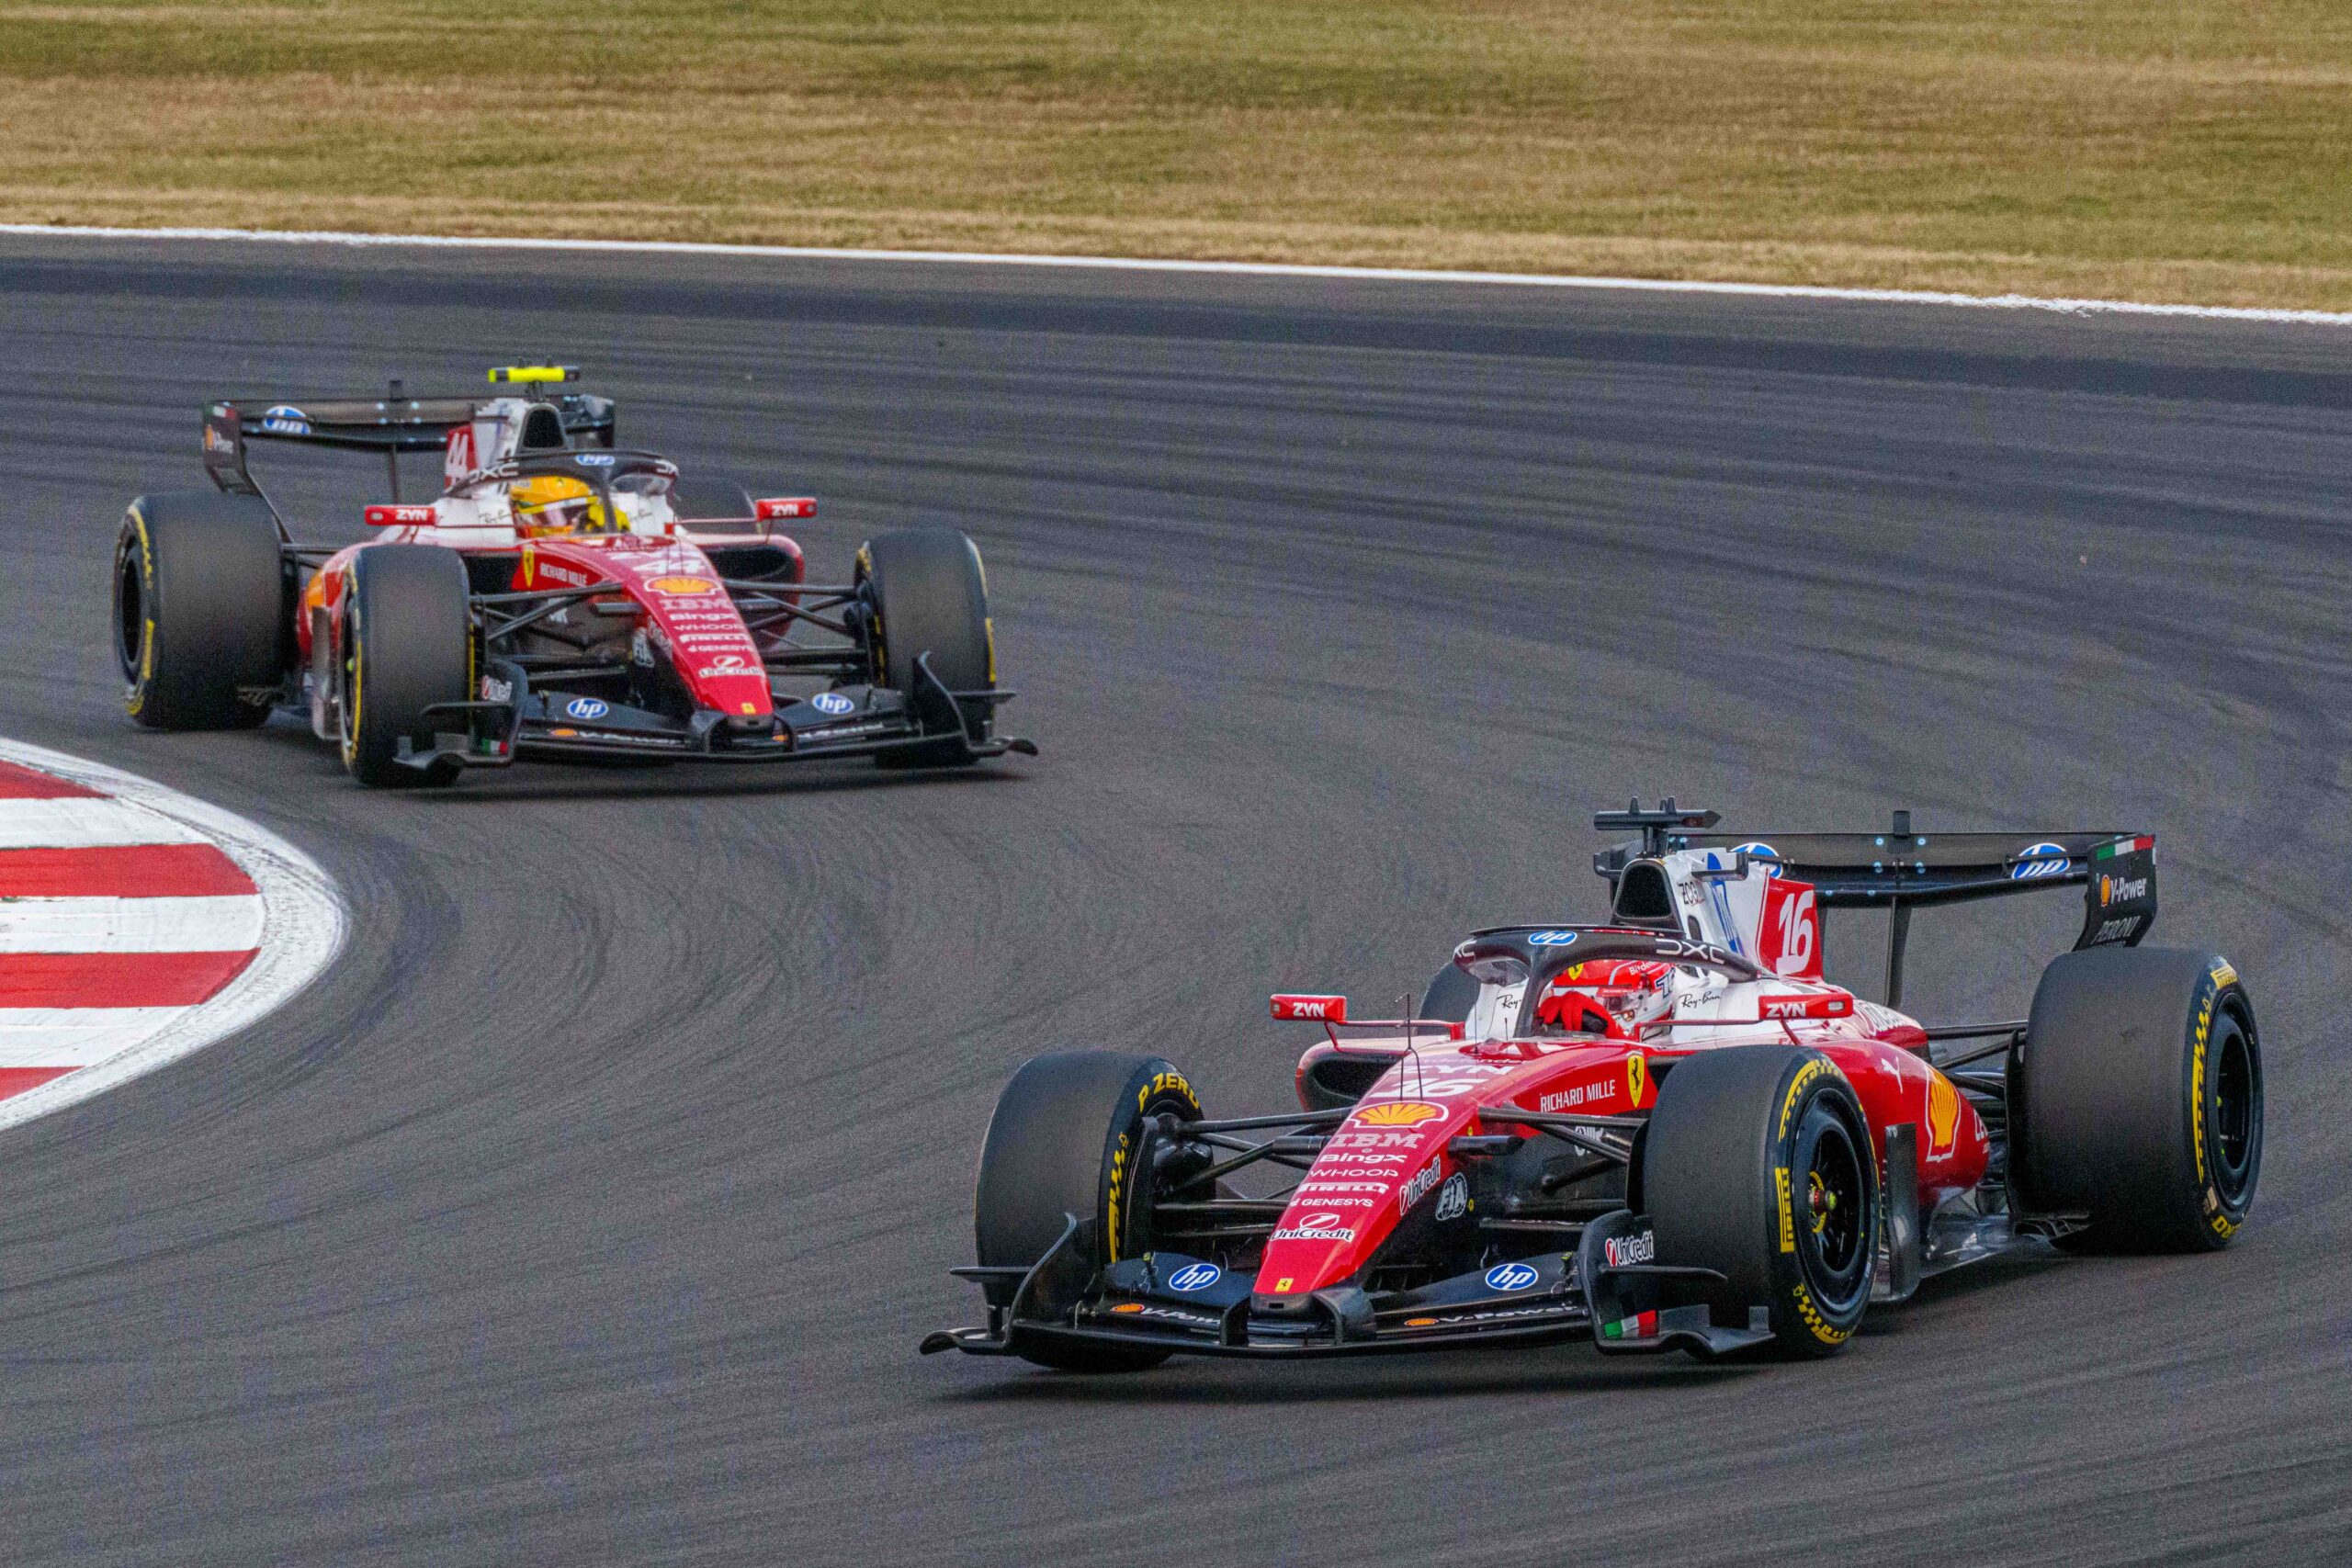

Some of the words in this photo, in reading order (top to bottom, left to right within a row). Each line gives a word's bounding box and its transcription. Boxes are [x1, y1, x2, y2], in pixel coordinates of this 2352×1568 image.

[396, 509, 428, 521] ZYN
[772, 503, 798, 516] ZYN
[2110, 877, 2147, 904] V-Power
[1533, 931, 1573, 945] hp
[1776, 889, 1815, 976] 16
[2091, 915, 2142, 944] PERONI
[1656, 938, 1725, 964] DXC
[1293, 1001, 1325, 1017] ZYN
[1679, 990, 1721, 1009] Ray-Ban
[1766, 1003, 1806, 1017] ZYN
[1392, 1066, 1515, 1075] ZYN
[1369, 1078, 1489, 1098] 16
[1541, 1087, 1584, 1112] RICHARD
[1587, 1079, 1615, 1101] MILLE
[1138, 1084, 1149, 1114] P
[1331, 1134, 1425, 1148] IBM
[1299, 1182, 1389, 1194] PIRELLI
[1301, 1198, 1374, 1207] GENESYS
[1775, 1168, 1794, 1253] PIRELLI
[1272, 1229, 1355, 1242] UniCredit
[1616, 1231, 1653, 1265] UniCredit
[1174, 1264, 1216, 1291] hp
[1492, 1264, 1533, 1291] hp
